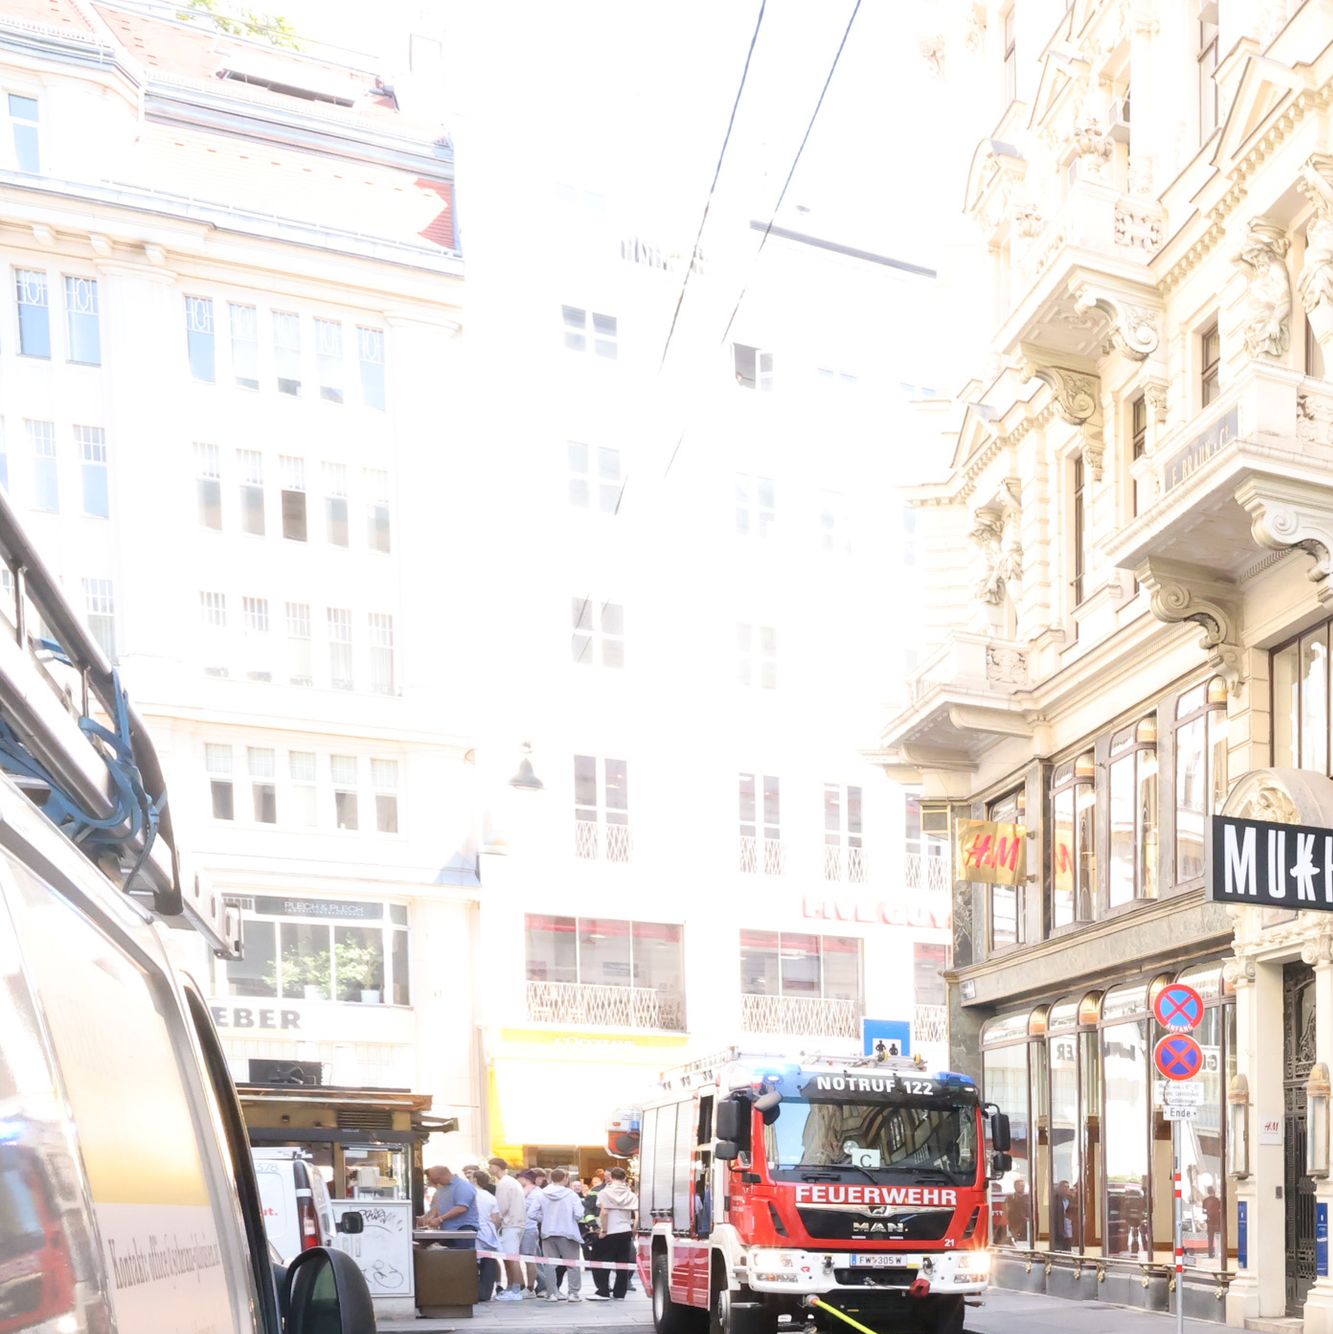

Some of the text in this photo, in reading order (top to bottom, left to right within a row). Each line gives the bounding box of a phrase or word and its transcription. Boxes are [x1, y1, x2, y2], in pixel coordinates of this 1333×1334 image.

[817, 1076, 934, 1095] NOTRUF 122
[1170, 1107, 1191, 1118] Ende
[860, 1154, 872, 1168] C
[795, 1186, 957, 1205] FEUERWEHR
[853, 1222, 904, 1233] MAN
[944, 1238, 955, 1247] 21
